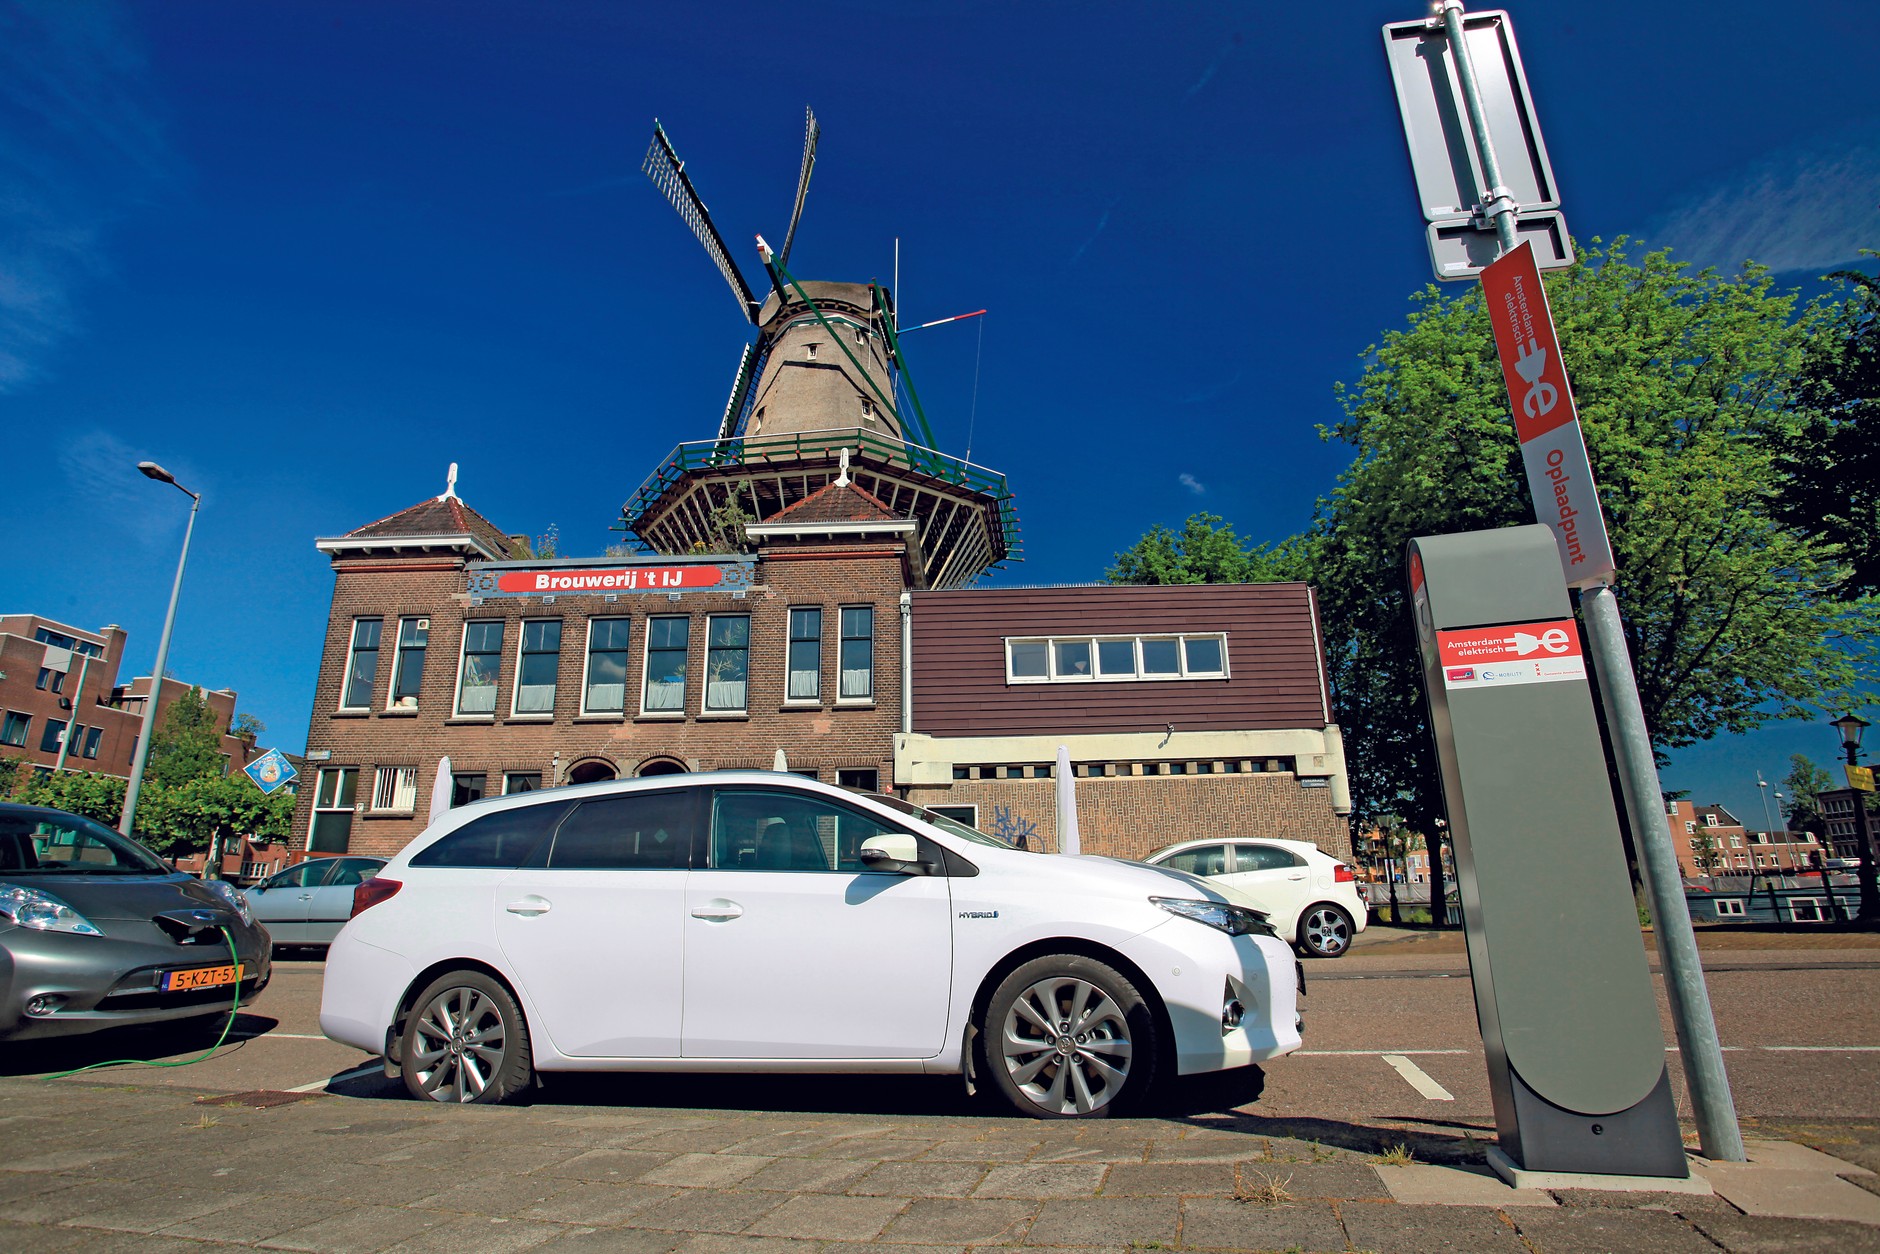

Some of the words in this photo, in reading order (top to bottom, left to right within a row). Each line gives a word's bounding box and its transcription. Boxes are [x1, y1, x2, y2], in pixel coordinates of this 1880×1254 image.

[1512, 275, 1534, 338] Amsterdam
[1504, 292, 1523, 345] elektrisch
[1545, 449, 1586, 565] Oplaadpunt
[535, 571, 637, 589] Brouwerij
[644, 571, 656, 586] 't
[662, 571, 683, 586] IJ
[1447, 637, 1503, 649] Amsterdam
[1458, 646, 1504, 656] elektrisch
[959, 911, 993, 919] HYBRID
[176, 967, 238, 987] 5-KZT-57
